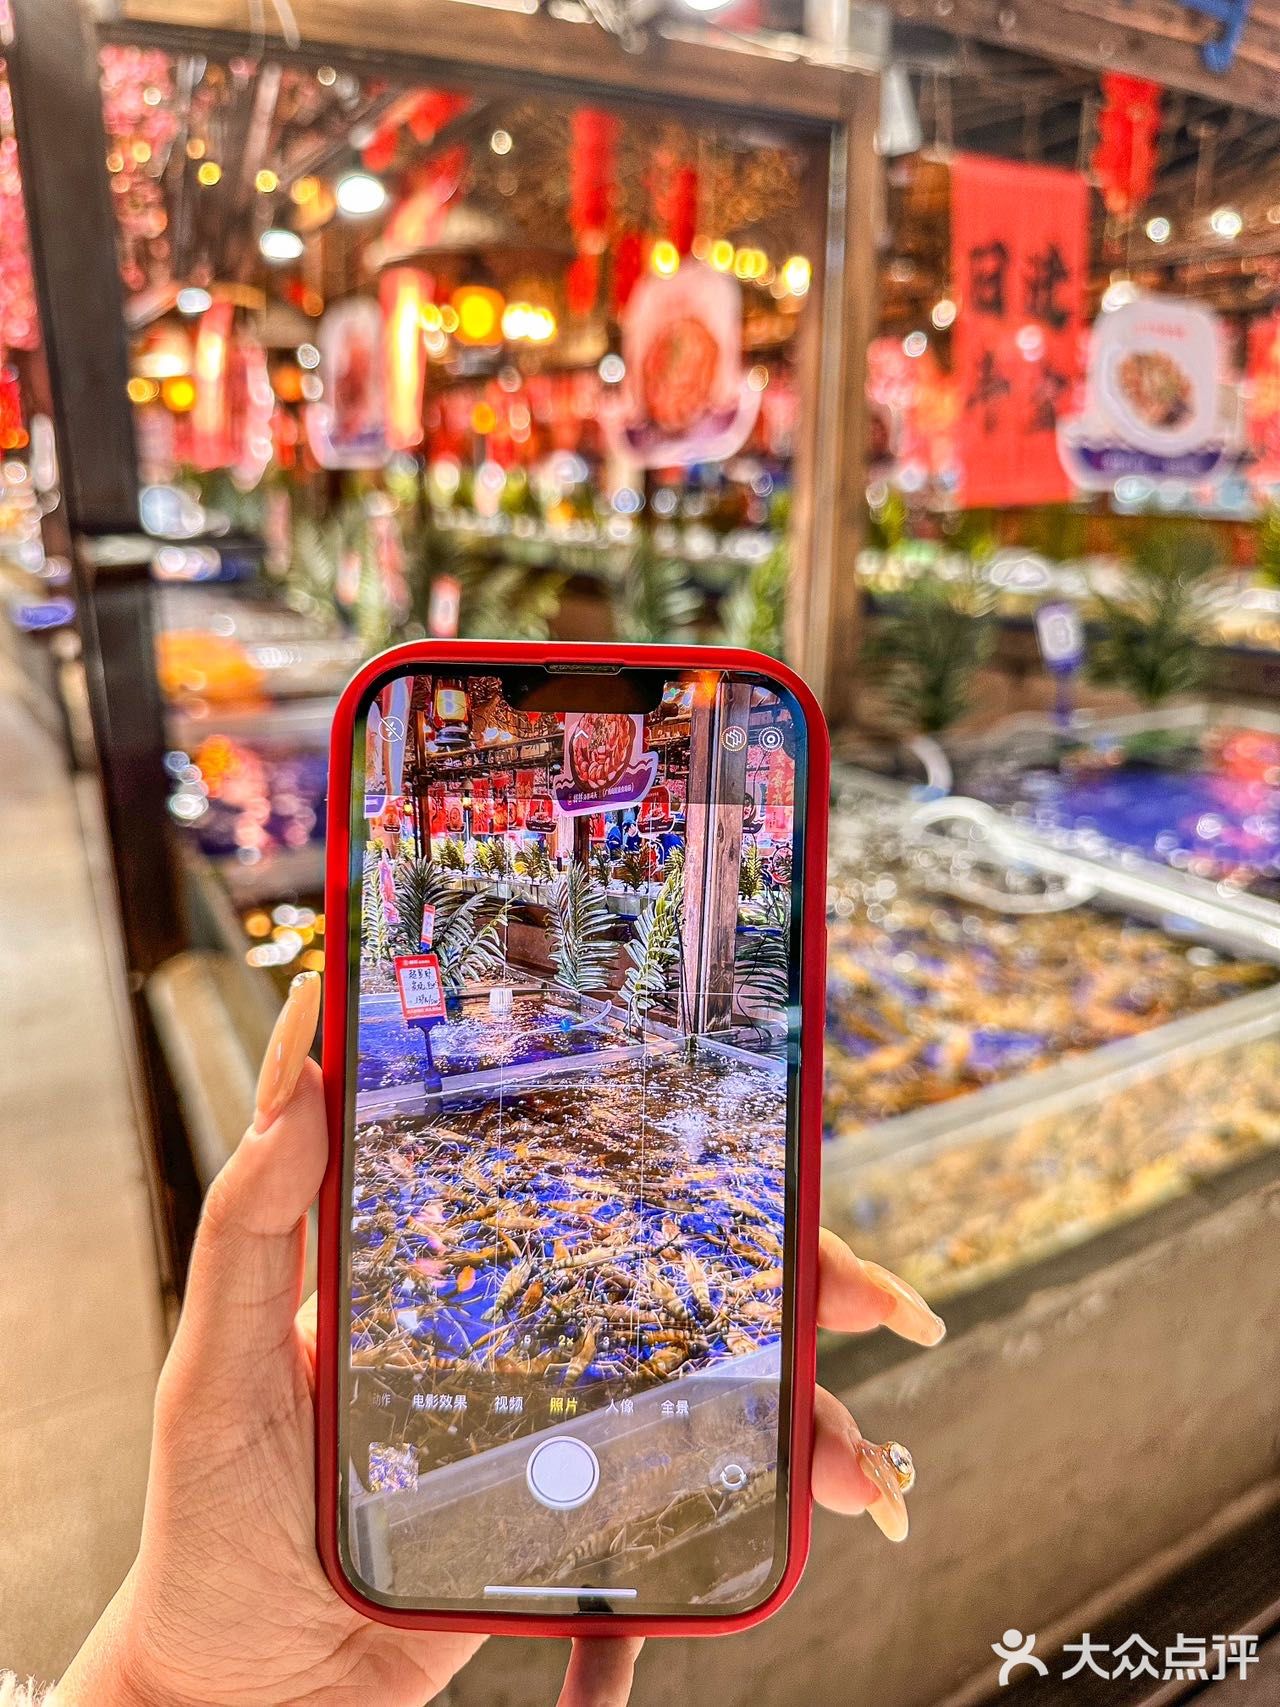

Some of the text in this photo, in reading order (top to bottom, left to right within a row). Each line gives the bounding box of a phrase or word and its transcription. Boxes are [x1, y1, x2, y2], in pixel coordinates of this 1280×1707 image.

[413, 1394, 467, 1409] 电影效果
[495, 1396, 523, 1411] 视频
[550, 1398, 578, 1412] 照片
[605, 1399, 634, 1413] 人像
[661, 1400, 689, 1414] 全景
